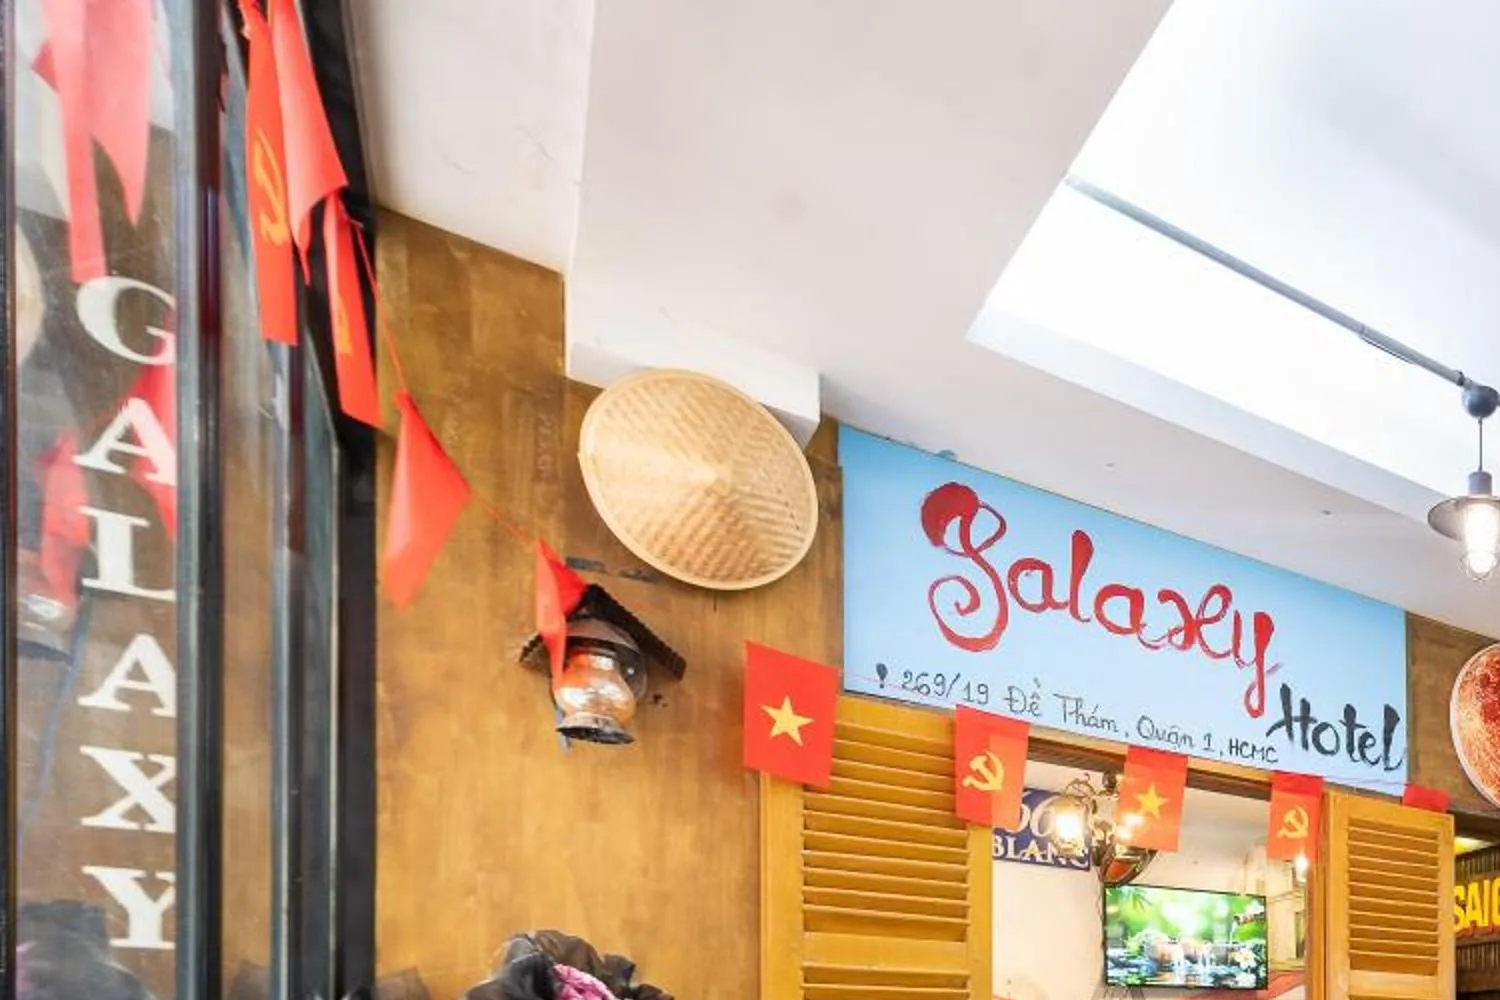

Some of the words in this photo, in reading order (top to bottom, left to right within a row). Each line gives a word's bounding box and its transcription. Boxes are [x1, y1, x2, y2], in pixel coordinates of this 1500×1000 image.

[901, 669, 990, 705] 269/19
[1228, 737, 1279, 764] HCMC
[1266, 682, 1404, 771] Hotel
